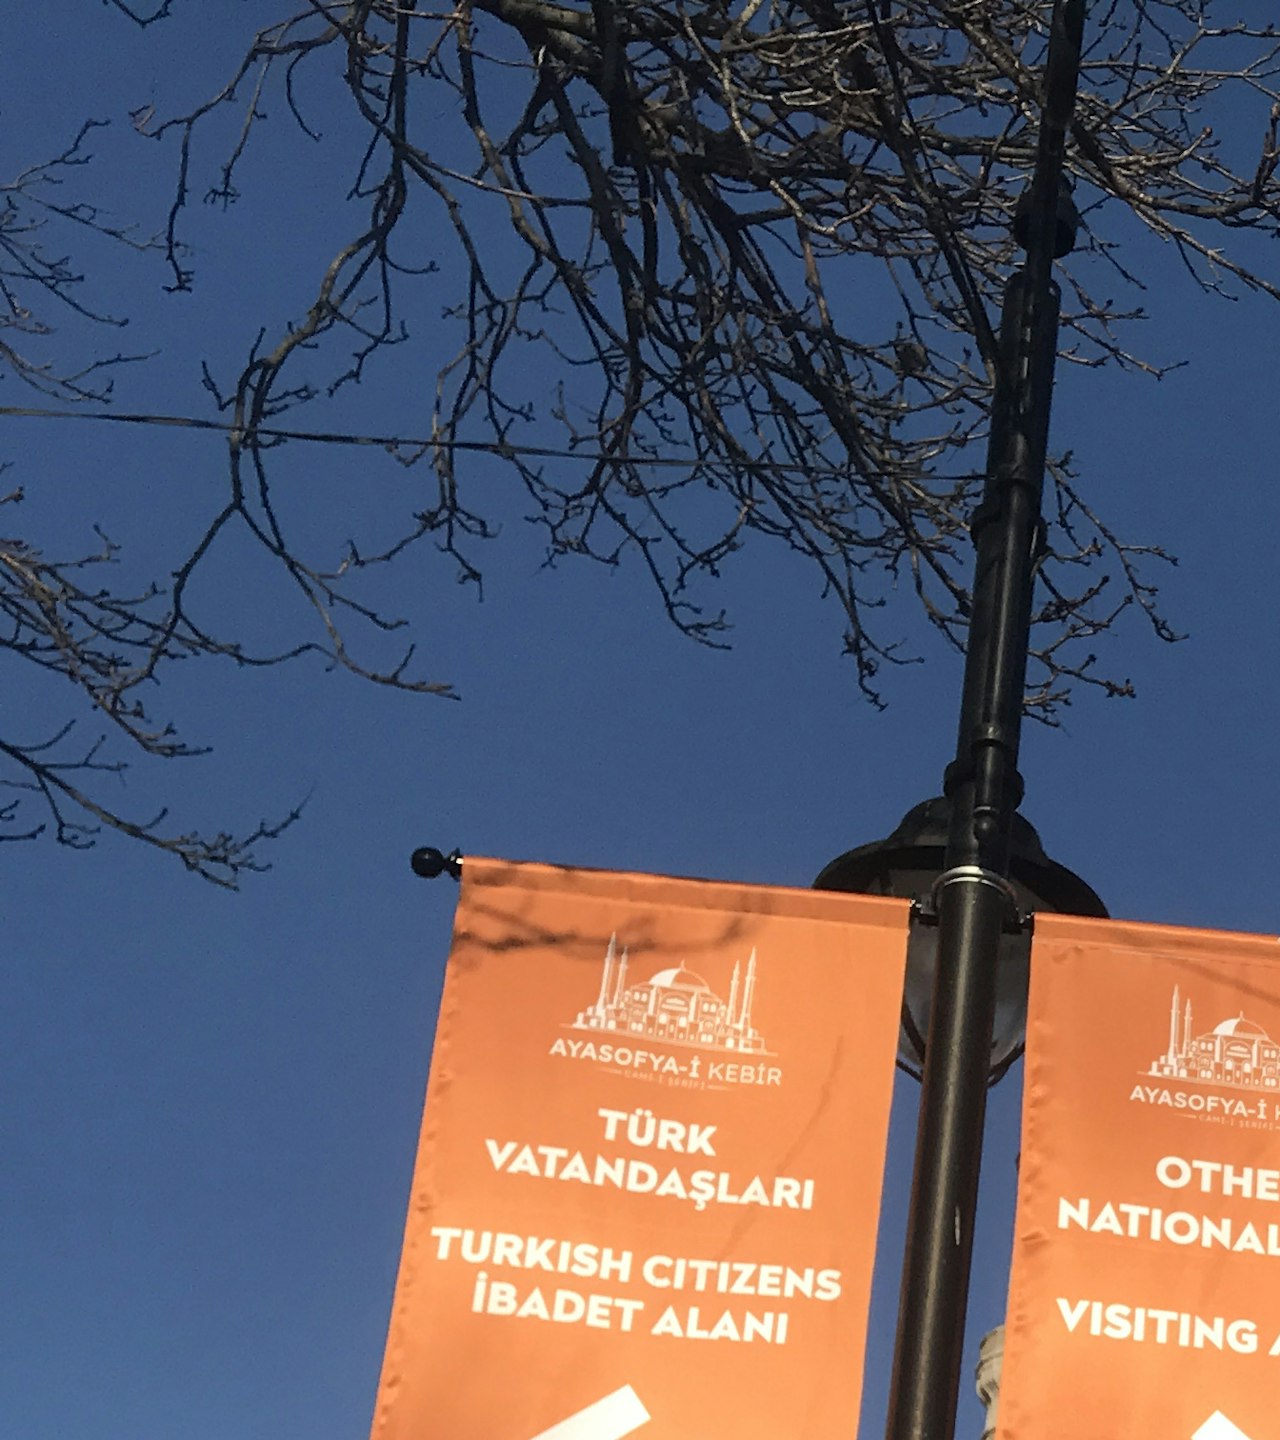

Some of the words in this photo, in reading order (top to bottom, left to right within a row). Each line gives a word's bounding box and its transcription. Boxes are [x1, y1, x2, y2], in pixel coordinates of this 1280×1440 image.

[550, 1037, 701, 1079] AYASOFYA-İ
[708, 1061, 783, 1087] KEBİR
[1130, 1085, 1267, 1120] AYASOFYA-İ
[598, 1107, 717, 1156] TÜRK
[486, 1139, 814, 1211] VATANDAŞLARI
[430, 1226, 632, 1282] TURKISH
[642, 1255, 842, 1300] CITIZENS
[471, 1272, 644, 1331] İBADET
[651, 1306, 789, 1345] ALANI
[1056, 1298, 1258, 1354] VISITING
